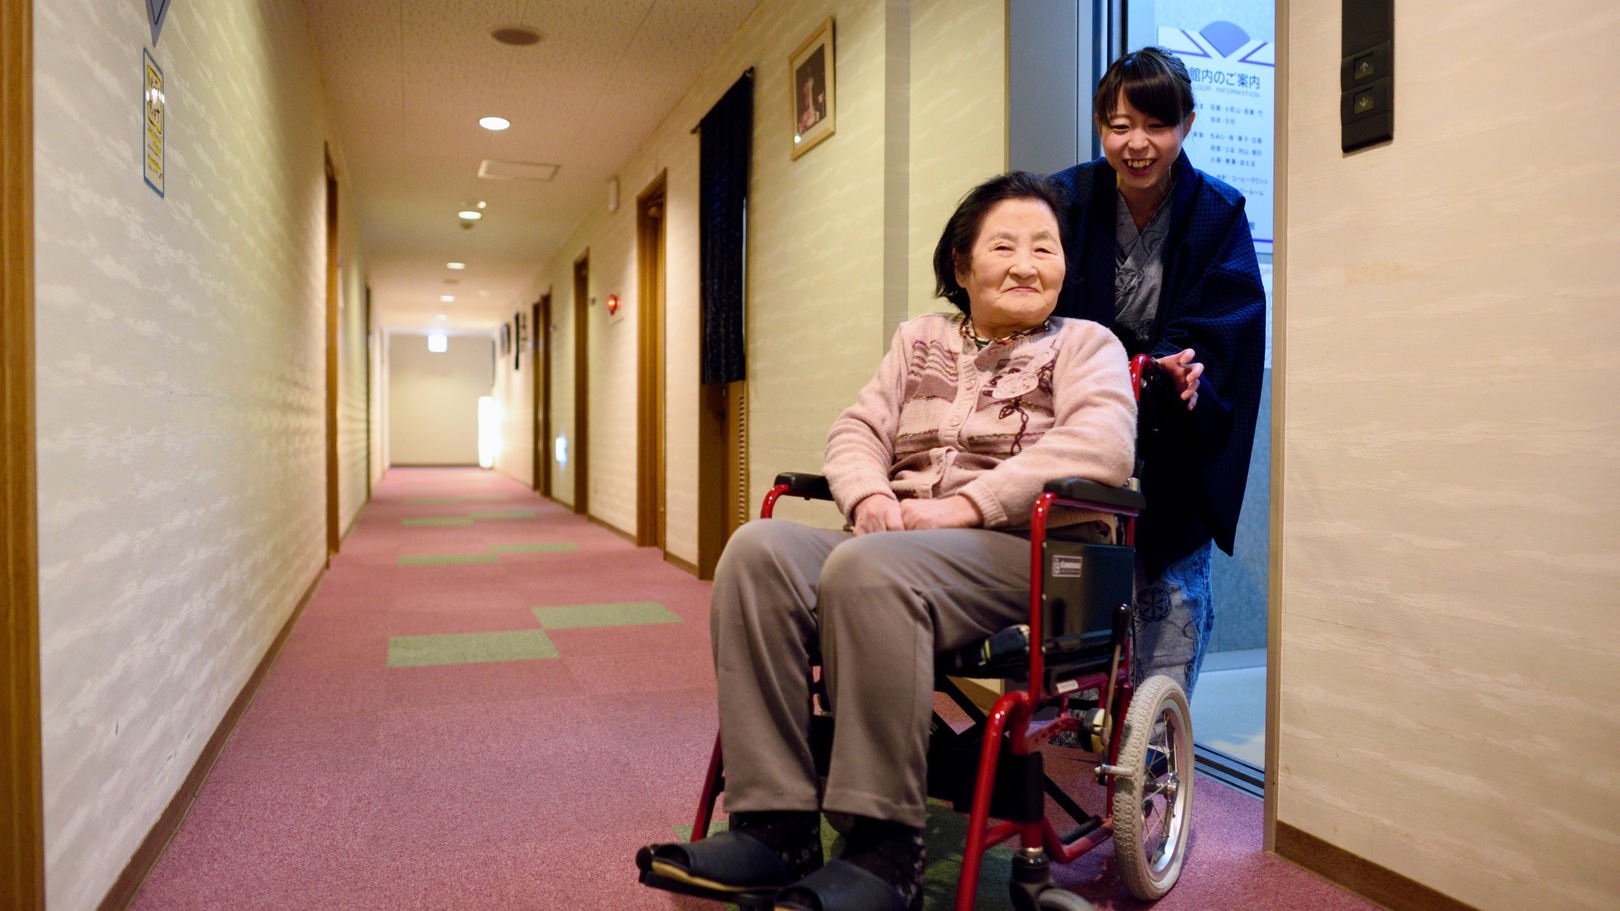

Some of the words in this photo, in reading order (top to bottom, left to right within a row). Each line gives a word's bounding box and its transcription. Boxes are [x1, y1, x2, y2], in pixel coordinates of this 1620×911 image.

[1189, 67, 1261, 90] 館内のご案内
[1192, 84, 1212, 93] LOOR
[1216, 87, 1261, 99] INFORMATION
